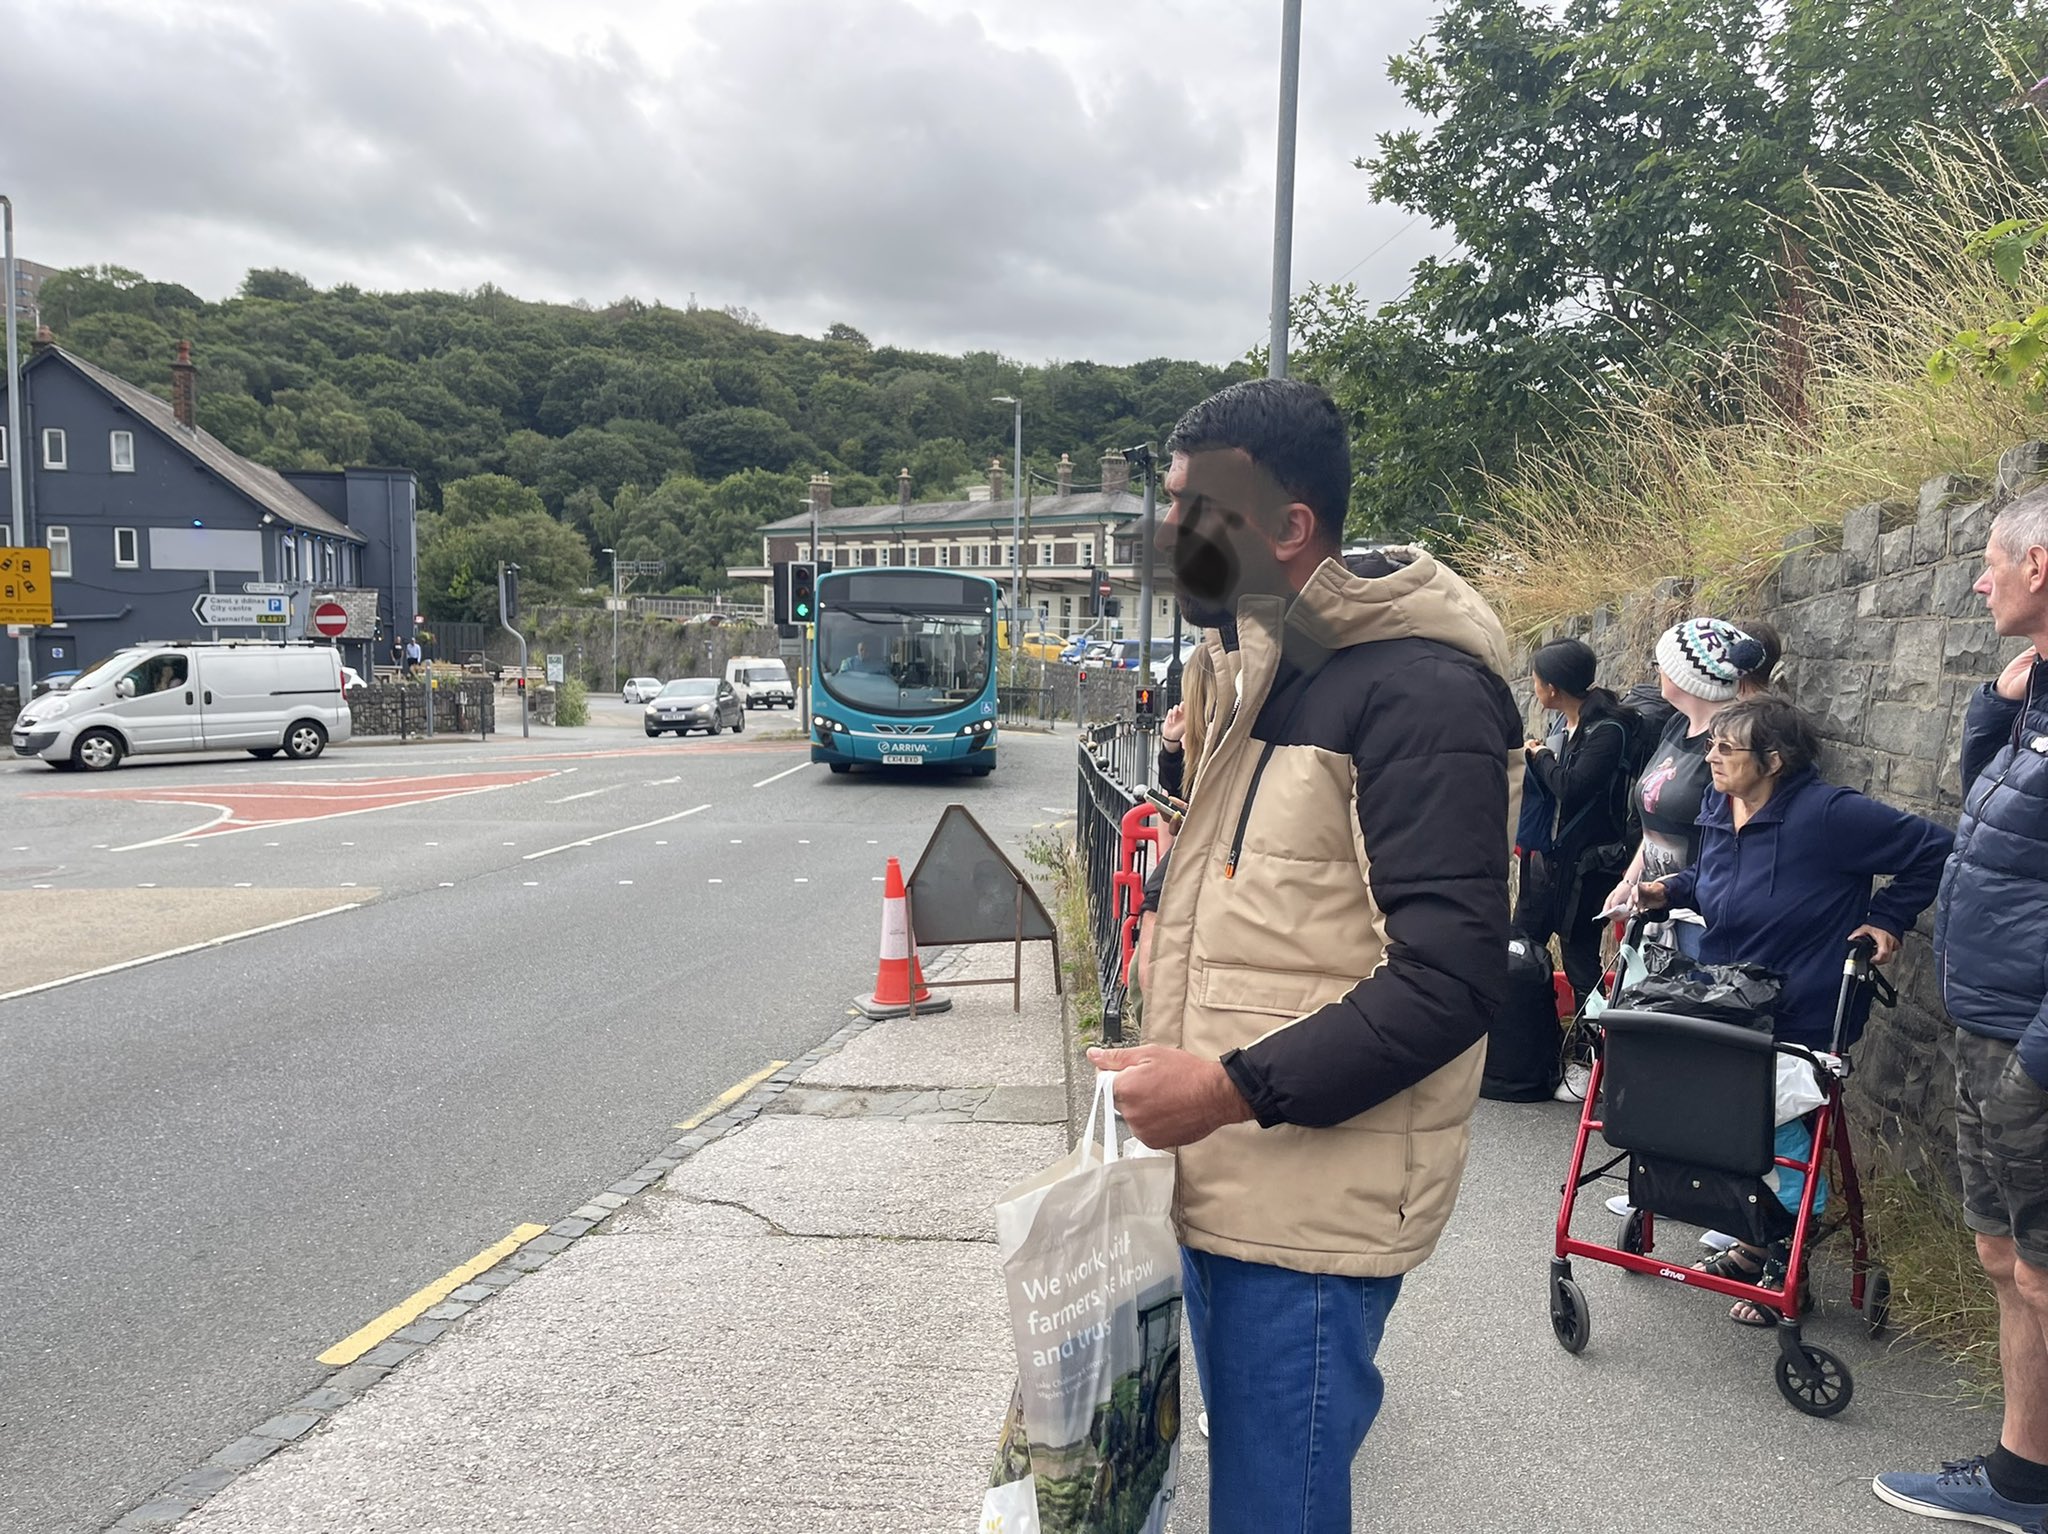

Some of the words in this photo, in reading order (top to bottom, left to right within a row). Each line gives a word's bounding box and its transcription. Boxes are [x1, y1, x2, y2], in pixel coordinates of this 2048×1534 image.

[892, 743, 927, 752] ARRIVA
[1021, 1275, 1061, 1303] We
[1065, 1247, 1107, 1287] work
[1660, 1267, 1685, 1281] drive
[1027, 1289, 1101, 1335] farmers
[1032, 1330, 1074, 1368] and
[1077, 1316, 1112, 1349] trus
